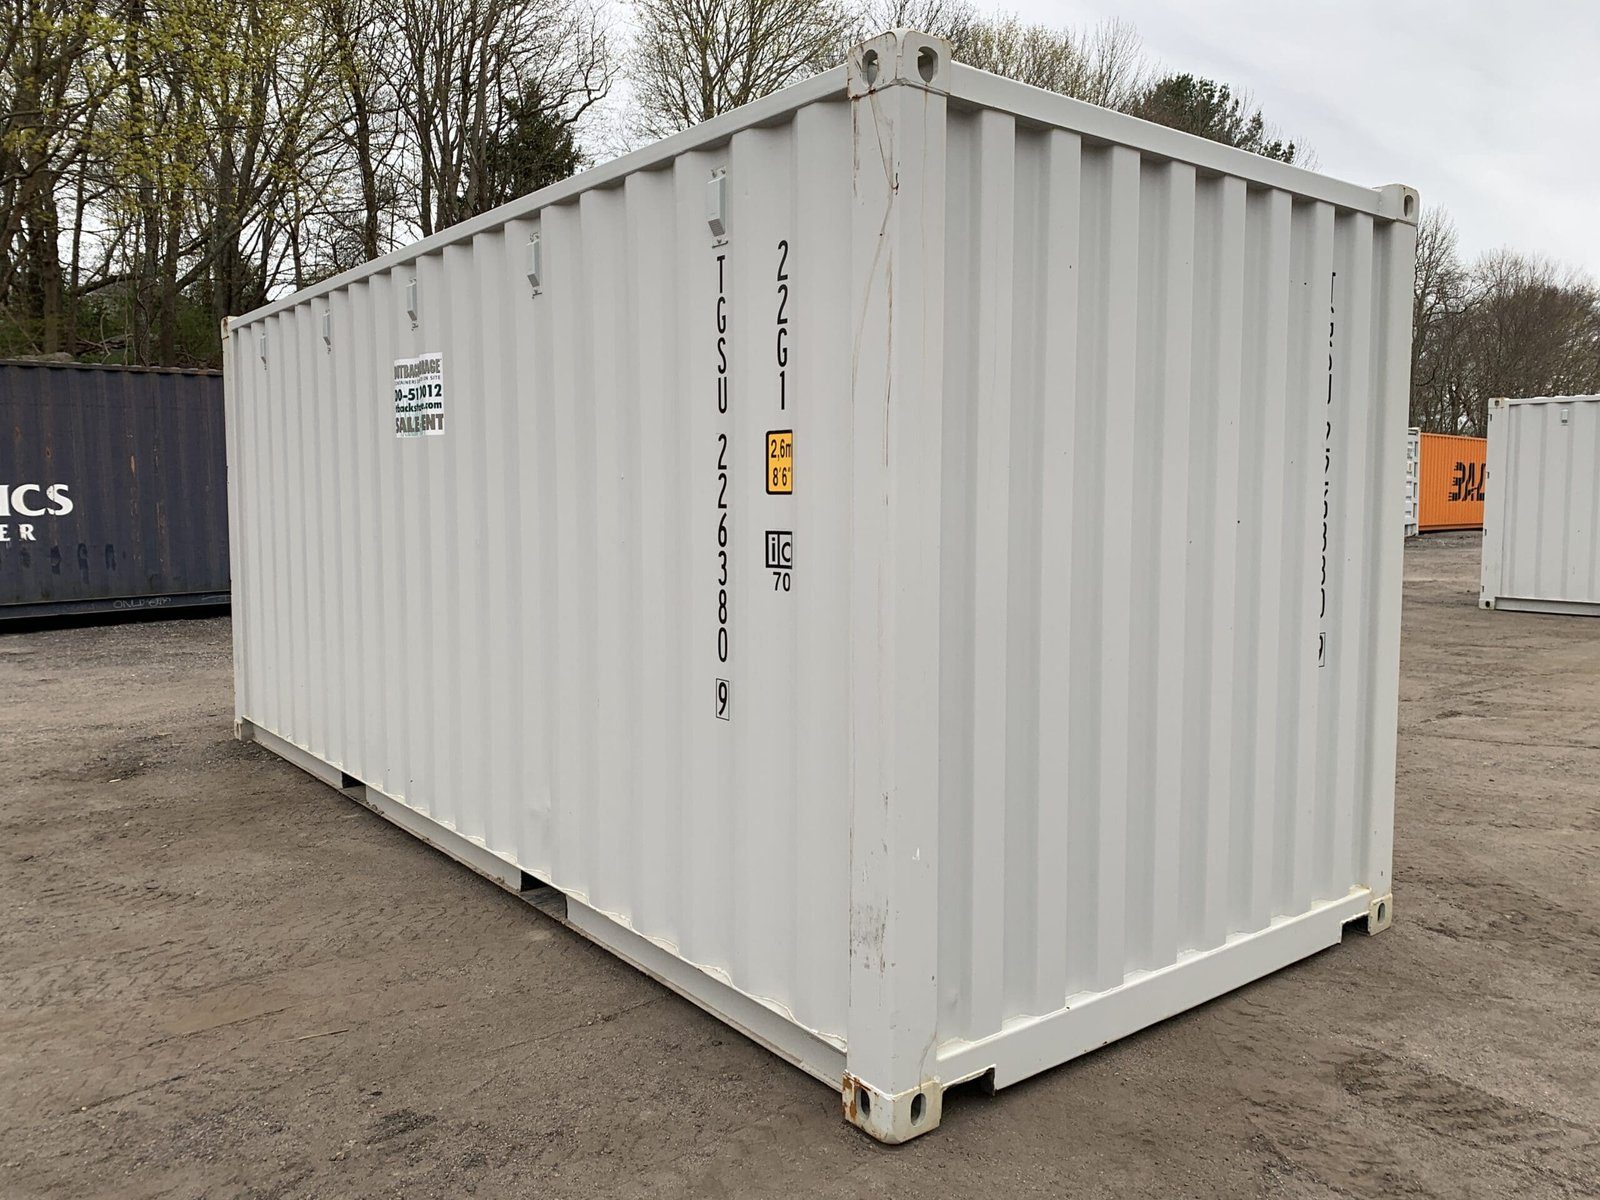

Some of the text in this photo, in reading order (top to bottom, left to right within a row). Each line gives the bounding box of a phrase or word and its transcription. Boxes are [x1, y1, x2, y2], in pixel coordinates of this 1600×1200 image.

[776, 239, 789, 411] 22G1
[716, 254, 728, 716] TGSU 226380 9
[772, 571, 791, 592] 70
